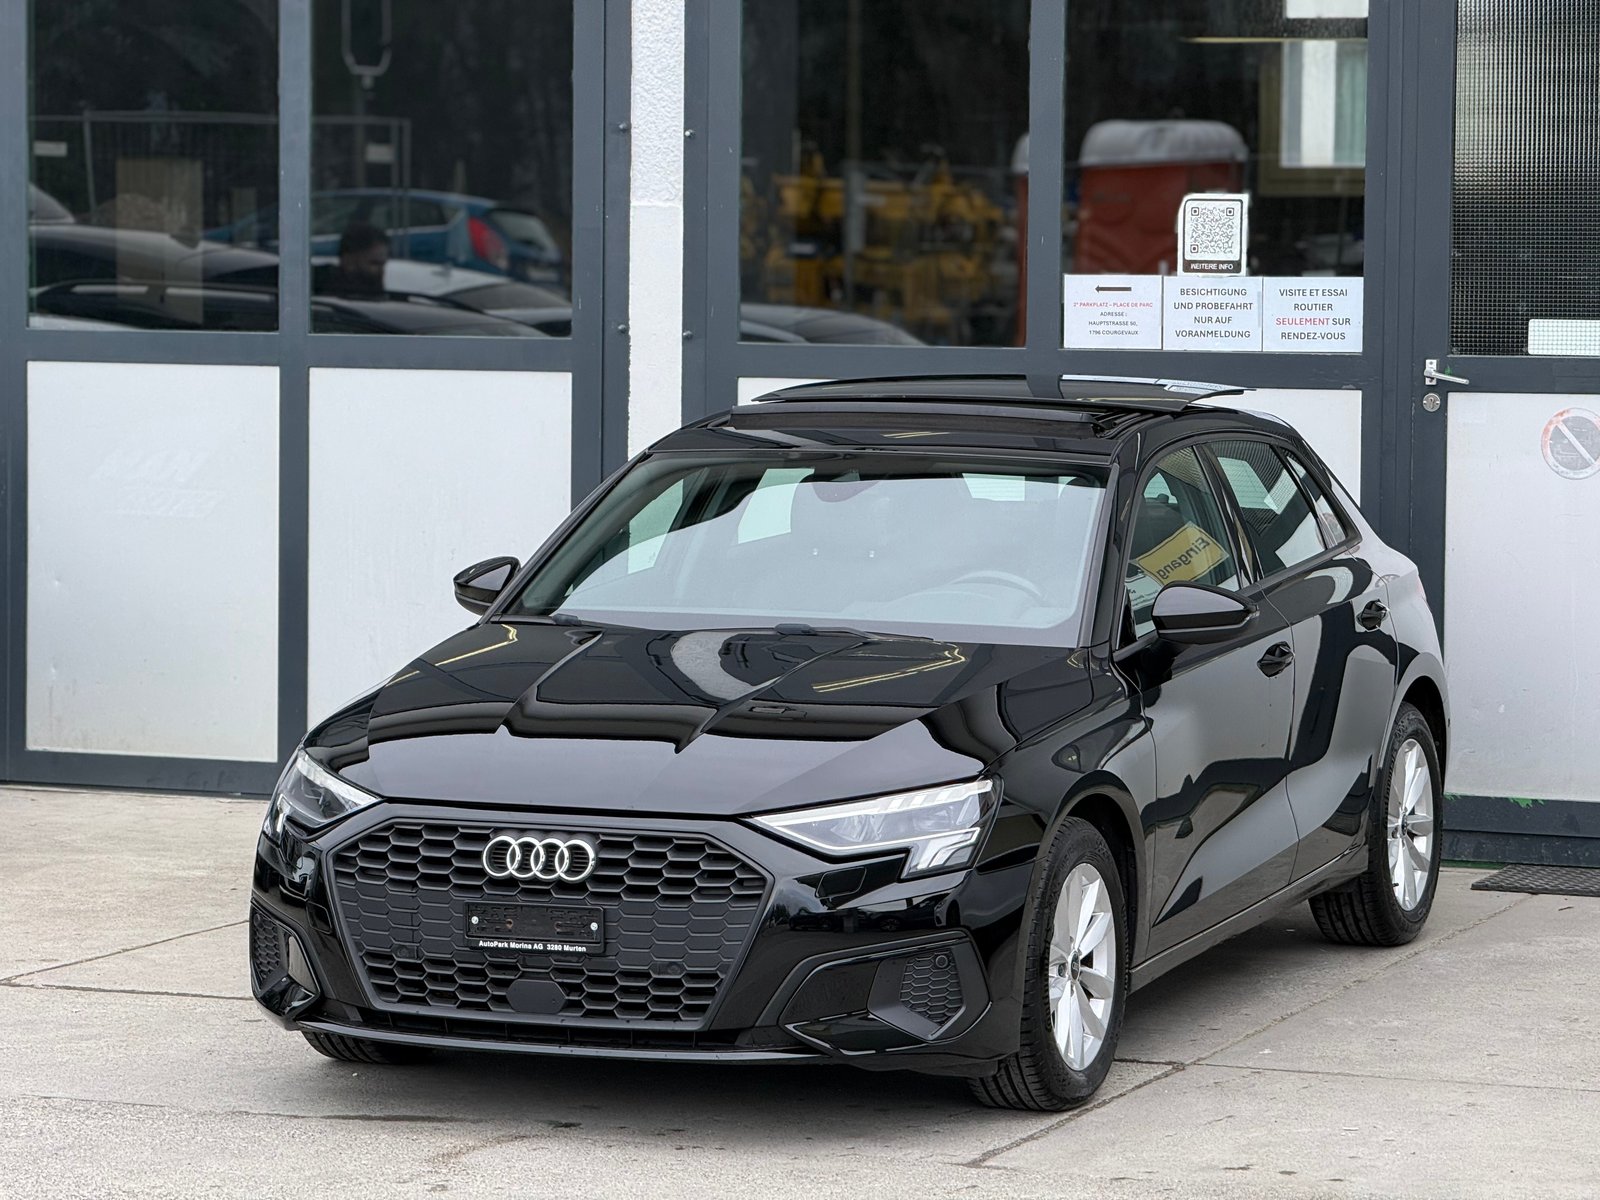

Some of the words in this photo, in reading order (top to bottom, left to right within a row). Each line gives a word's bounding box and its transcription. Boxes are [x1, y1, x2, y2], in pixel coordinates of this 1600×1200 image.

[1180, 288, 1247, 296] BESICHTIGUNG
[1195, 302, 1253, 310] PROBEFAHRT
[1293, 303, 1333, 311] ROUTIER
[1193, 316, 1213, 324] NUR
[1214, 316, 1233, 324] AUF
[1175, 330, 1251, 338] VORANMELDUNG
[1281, 332, 1346, 340] RENDEZ-VOUS
[479, 940, 509, 948] AutoPark
[510, 941, 532, 949] Morina
